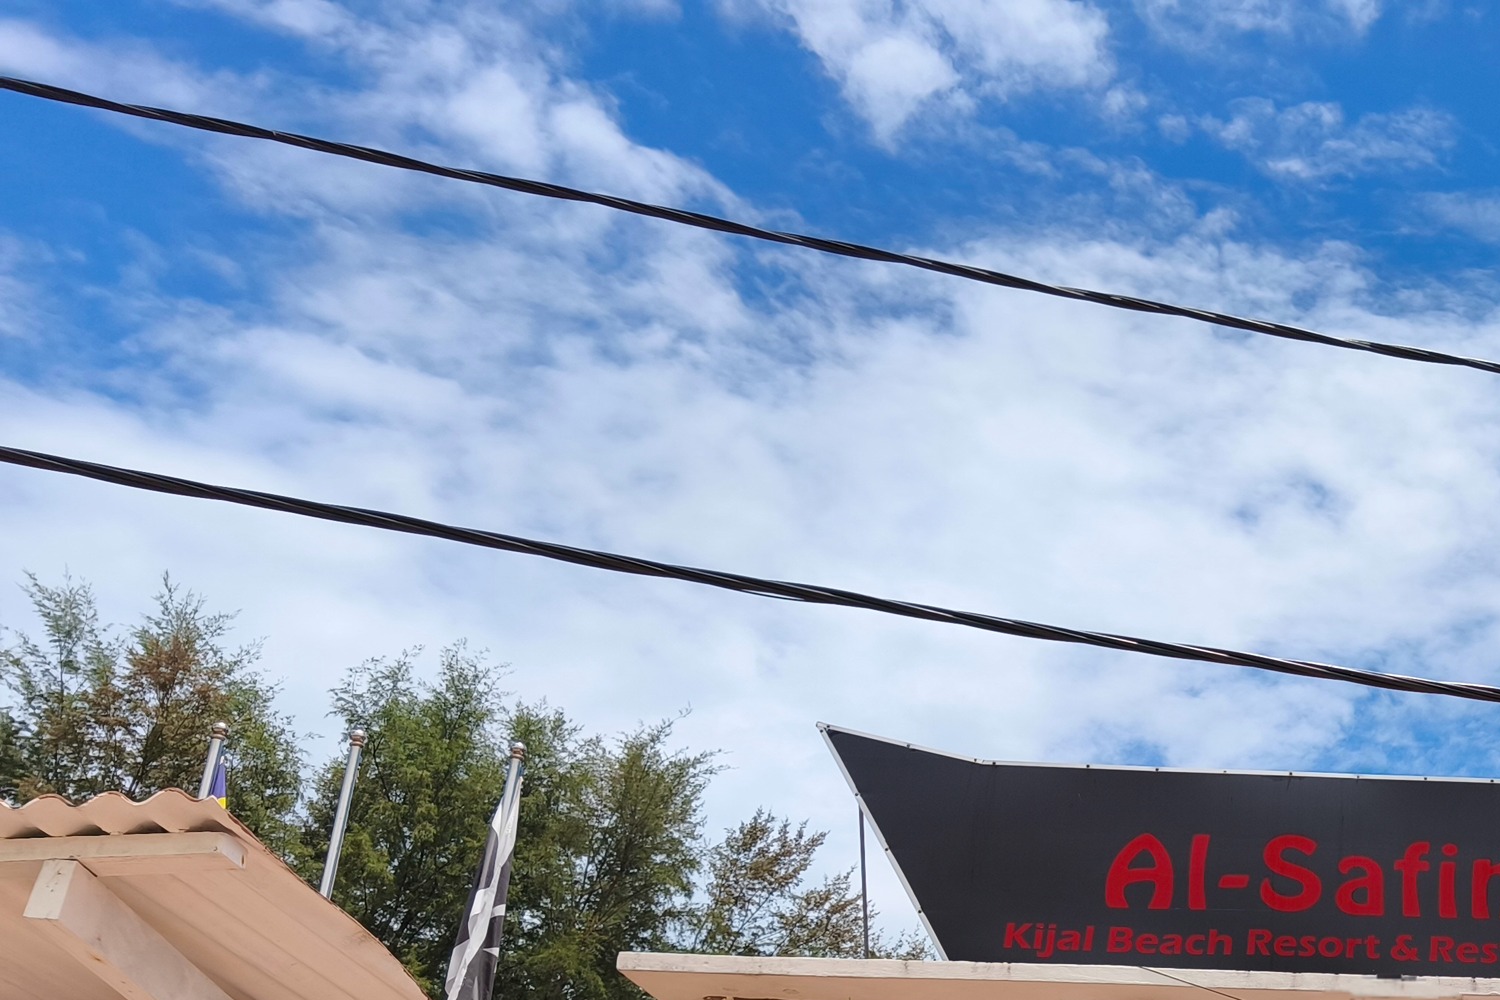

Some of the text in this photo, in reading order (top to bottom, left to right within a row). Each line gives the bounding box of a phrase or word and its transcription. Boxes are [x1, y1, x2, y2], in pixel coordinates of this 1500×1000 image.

[1003, 921, 1095, 959] Kijal
[1107, 925, 1233, 956] Beach
[1247, 929, 1381, 960] Resort
[1390, 934, 1418, 961] &
